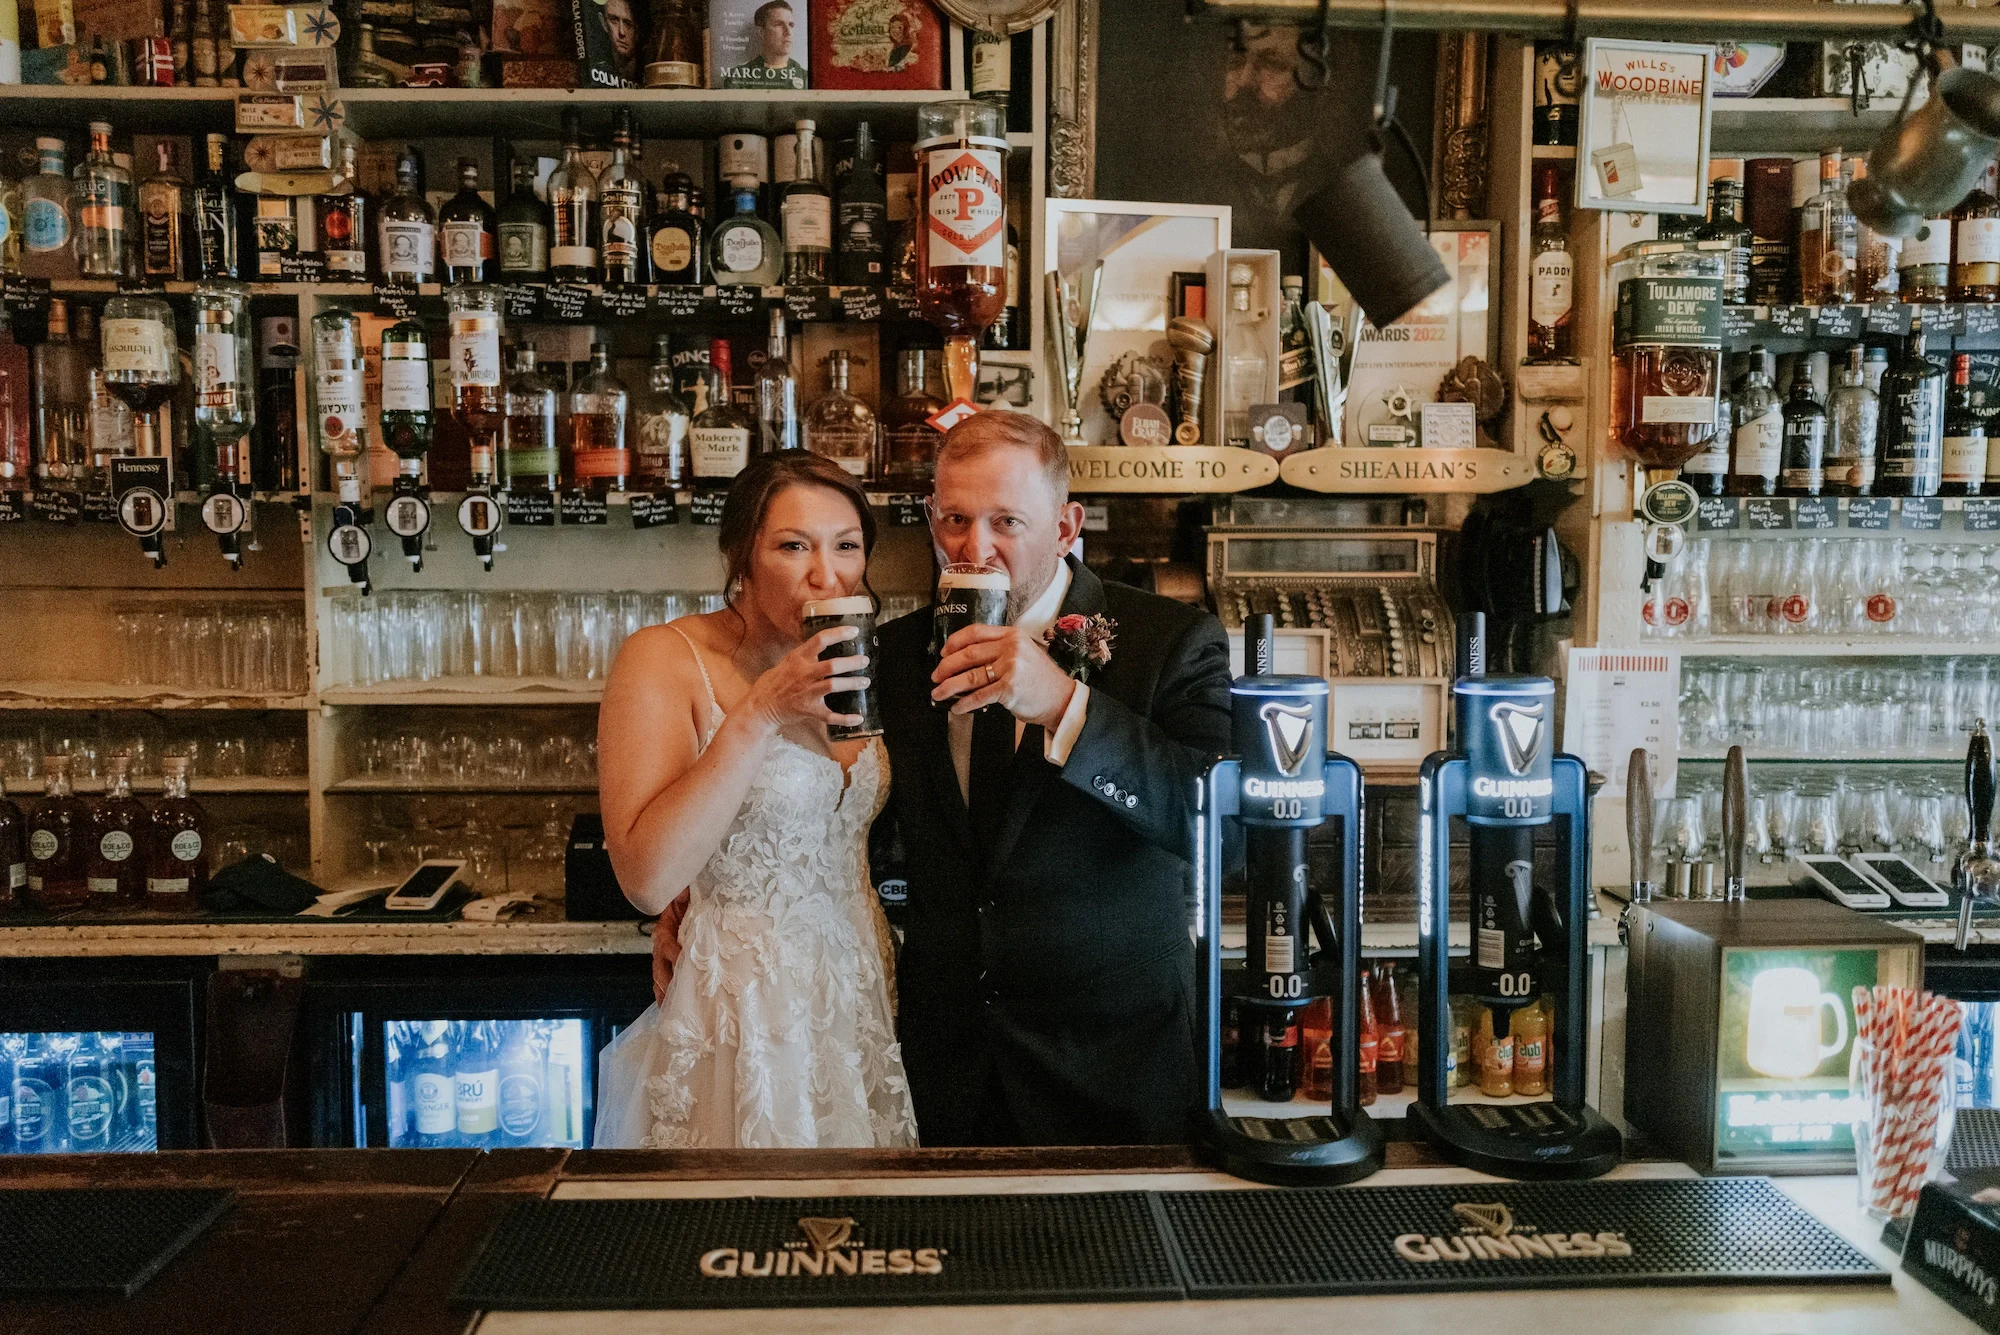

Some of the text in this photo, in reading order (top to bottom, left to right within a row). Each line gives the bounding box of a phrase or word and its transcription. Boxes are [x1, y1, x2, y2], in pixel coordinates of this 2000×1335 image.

[571, 0, 586, 60] OLM COOPER
[591, 67, 620, 89] COLM
[720, 64, 797, 80] MARC Ó SÉ
[1597, 70, 1702, 96] WOODBINE
[930, 164, 1000, 192] POWERS
[953, 187, 984, 221] P
[1831, 215, 1857, 224] KELLI
[1538, 266, 1572, 276] PADDY
[1646, 281, 1717, 300] TULLAMORE
[1413, 328, 1446, 342] 2022
[1654, 325, 1707, 333] IRISH WHISKEY
[672, 350, 711, 366] DING
[1131, 426, 1159, 438] CRAIG
[1132, 417, 1160, 429] ELIJAH
[694, 434, 741, 442] Maker's
[707, 443, 740, 453] Mark
[117, 462, 161, 474] Hennessy
[1069, 460, 1227, 478] WELCOME TO
[1339, 461, 1478, 479] SHEAHAN'S
[934, 602, 968, 615] INNESS
[1256, 637, 1268, 676] NNESS
[1469, 635, 1481, 675] NNESS
[1273, 799, 1302, 819] 0.0
[1504, 798, 1533, 818] 0.0
[880, 883, 908, 896] CBE
[1269, 974, 1303, 999] 0.0
[1499, 972, 1531, 997] 0.0
[1519, 1041, 1541, 1058] club
[419, 1101, 450, 1112] DINGER
[1394, 1232, 1632, 1263] GUINNESS
[700, 1248, 944, 1278] GUINNESS
